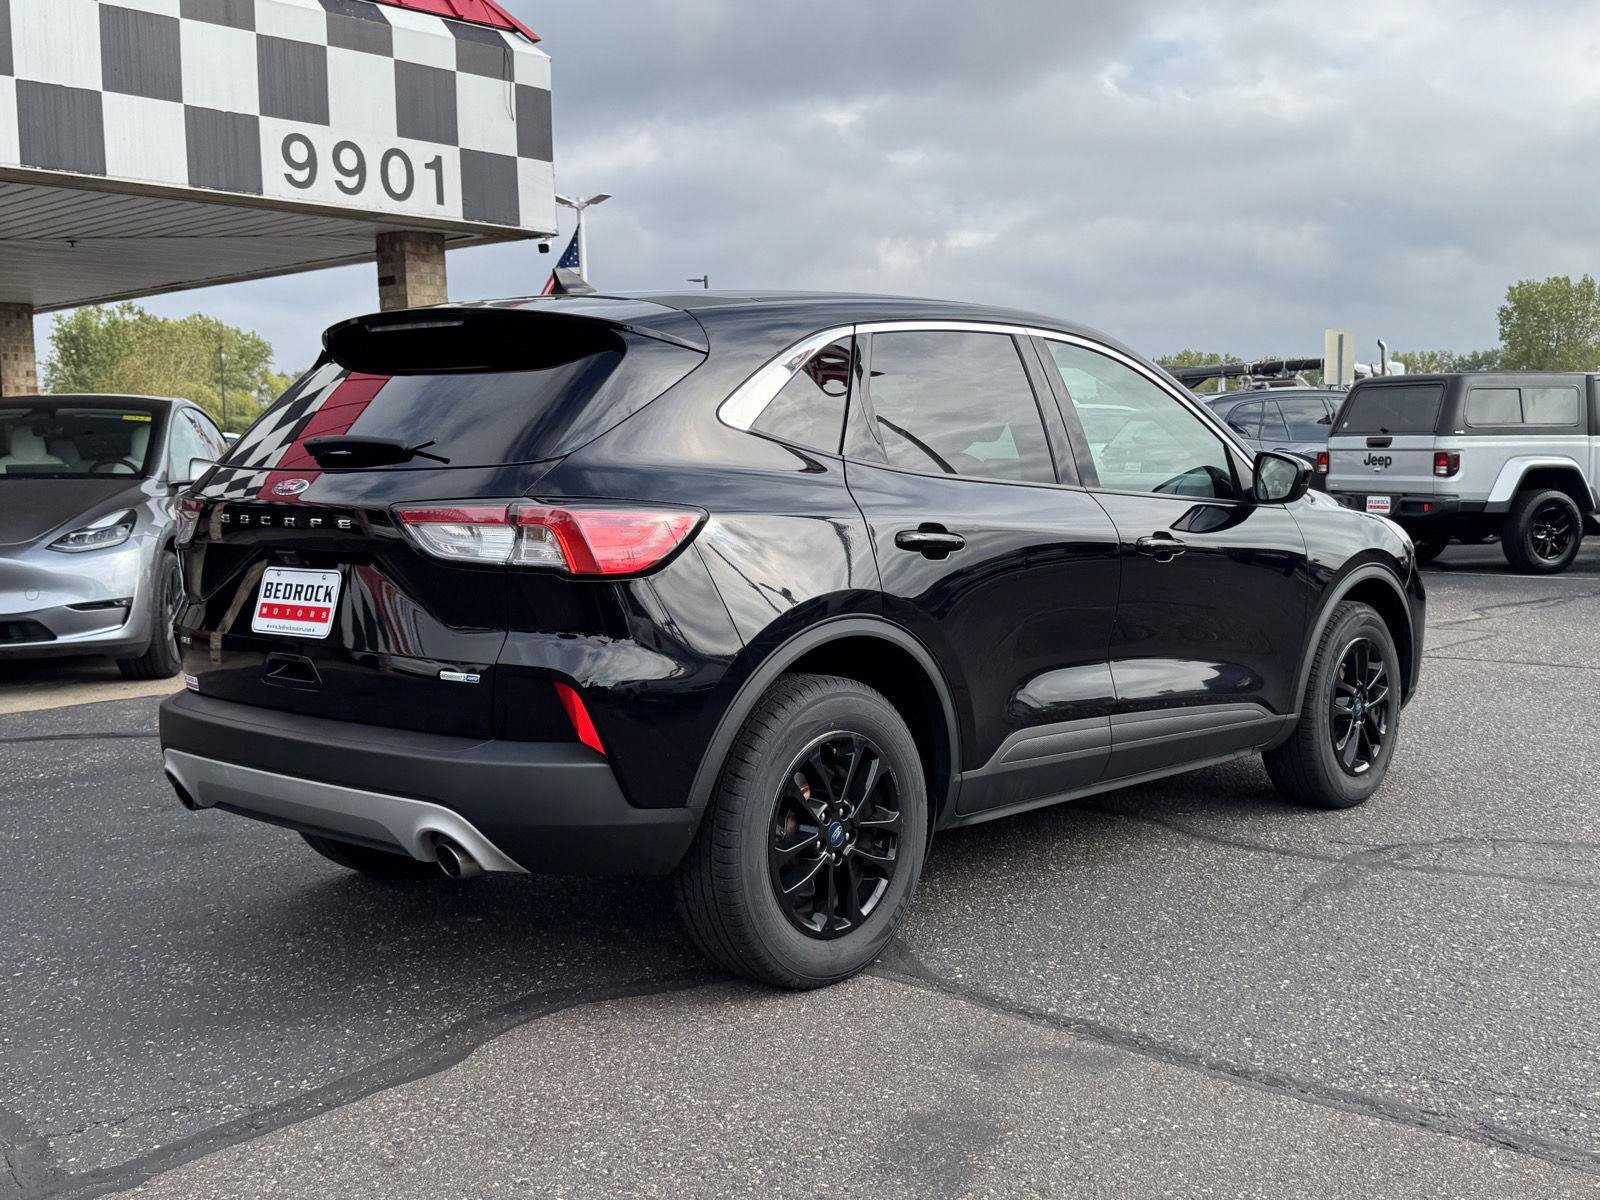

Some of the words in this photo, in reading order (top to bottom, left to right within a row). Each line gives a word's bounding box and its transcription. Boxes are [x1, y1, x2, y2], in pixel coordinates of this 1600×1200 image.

[281, 132, 445, 206] 9901
[1363, 452, 1392, 469] Jeep
[262, 581, 335, 603] BEDROCK
[261, 606, 328, 619] MOTORS
